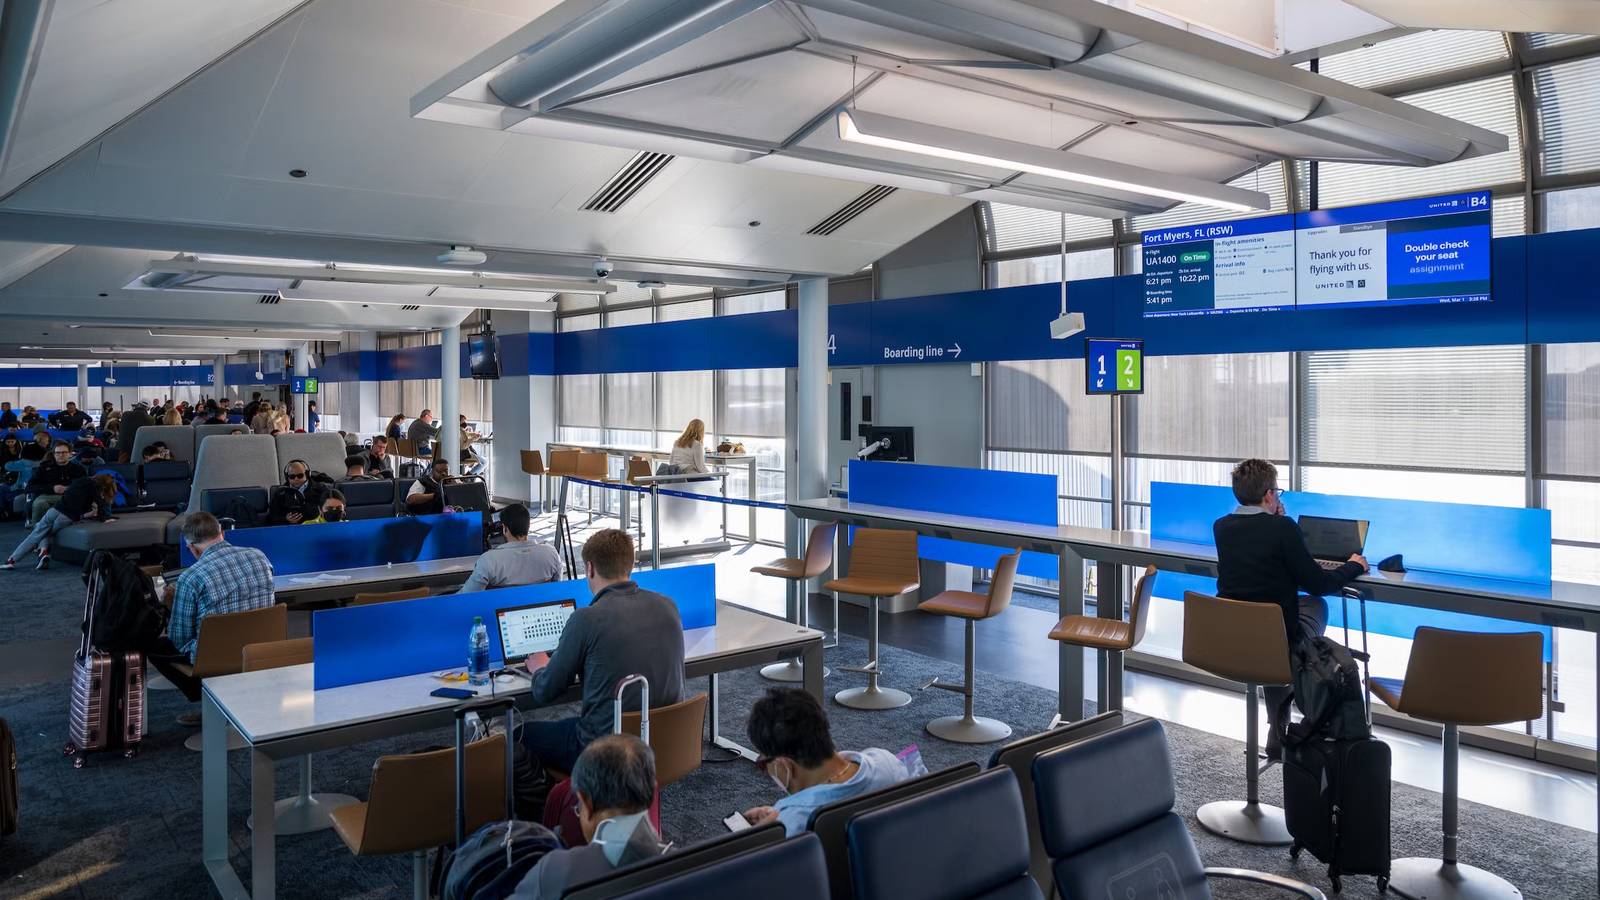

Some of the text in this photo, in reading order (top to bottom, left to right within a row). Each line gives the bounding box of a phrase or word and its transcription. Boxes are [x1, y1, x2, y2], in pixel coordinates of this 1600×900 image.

[1471, 196, 1487, 207] B4
[1144, 226, 1233, 243] Fort Myers, FL (RSW)
[1237, 237, 1265, 245] amenities
[1405, 240, 1469, 253] Double check
[1309, 247, 1372, 261] Thank you for
[1415, 251, 1458, 263] your seat
[1146, 255, 1177, 266] UA1400
[1309, 262, 1372, 276] flying with us.
[1409, 263, 1464, 274] assignment
[1160, 278, 1172, 286] pm
[1198, 275, 1209, 283] pm
[884, 345, 944, 360] Boarding line
[1098, 355, 1133, 375] 1 2
